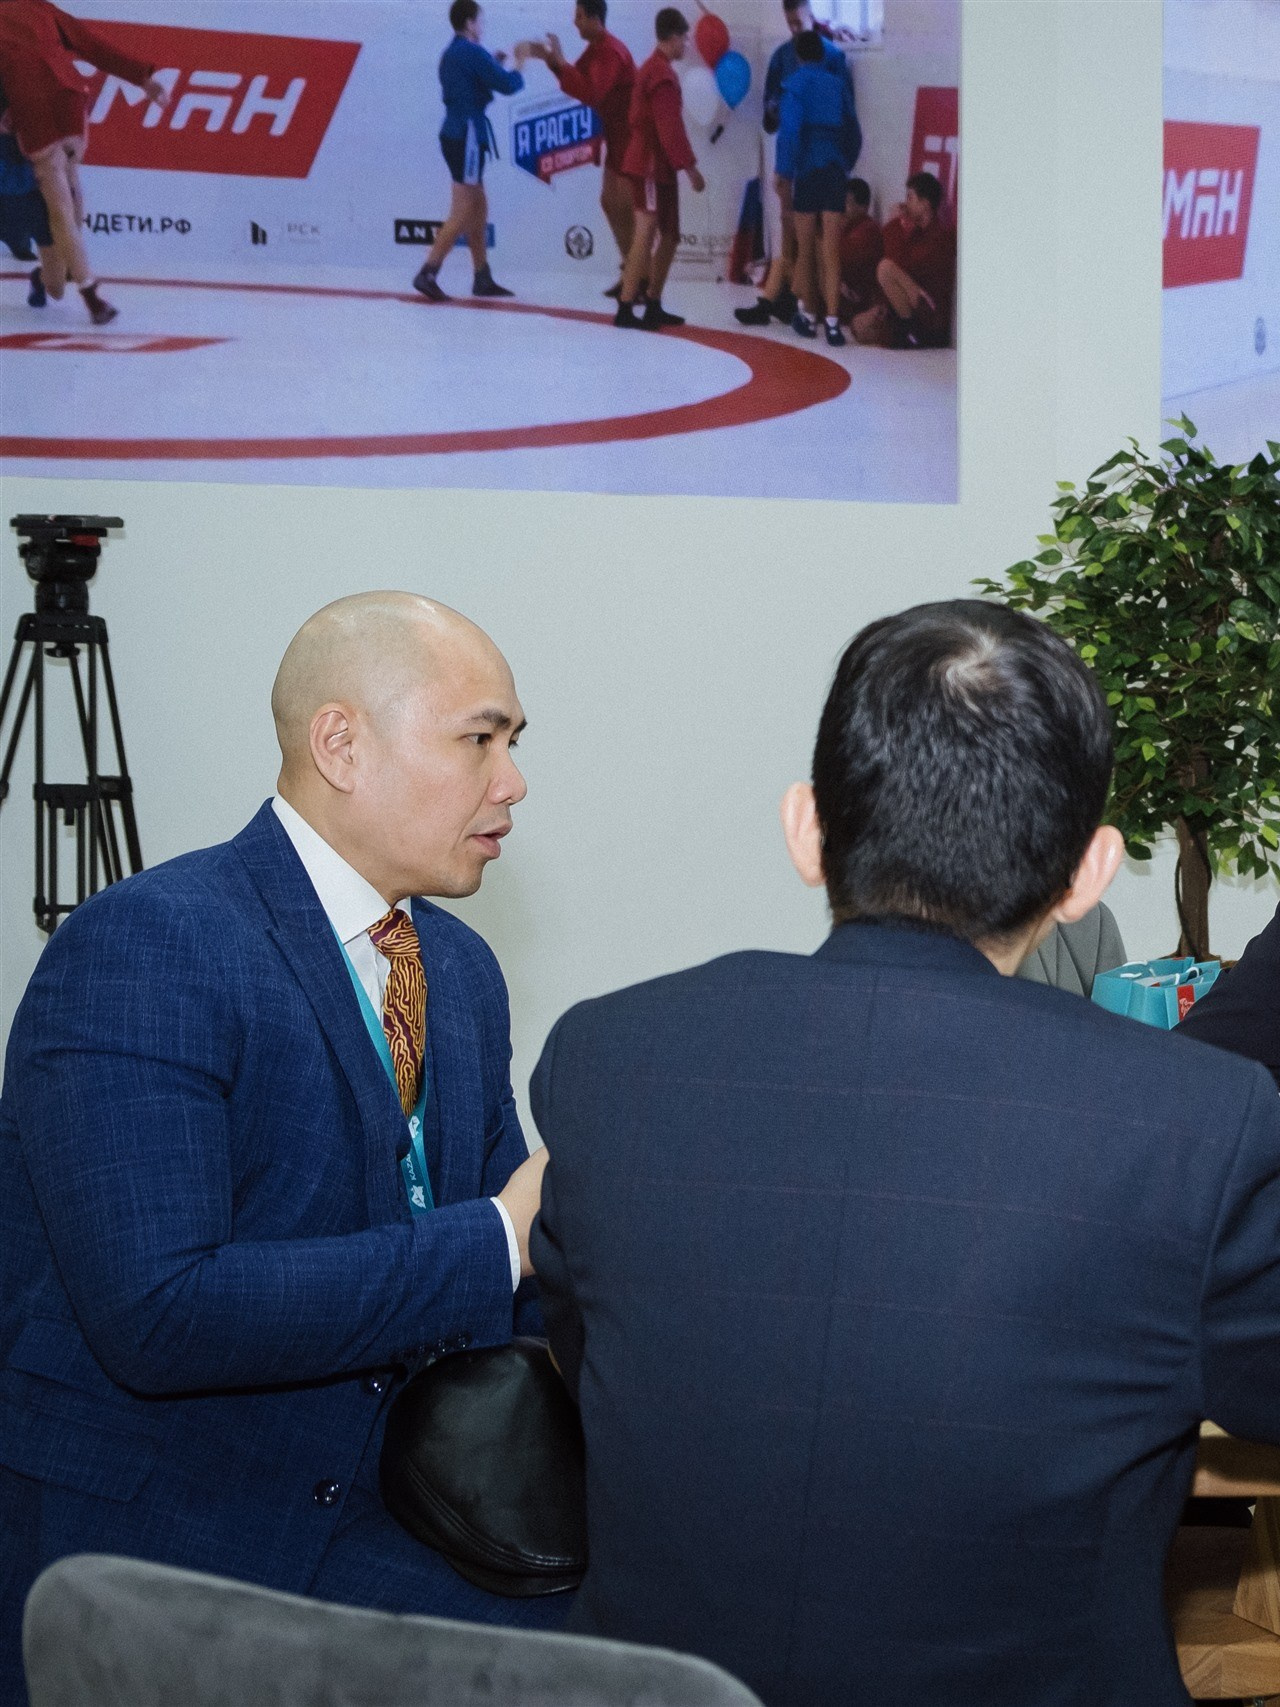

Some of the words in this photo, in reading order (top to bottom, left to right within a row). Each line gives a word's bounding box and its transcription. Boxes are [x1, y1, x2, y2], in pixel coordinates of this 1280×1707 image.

[72, 59, 306, 137] МАН
[535, 106, 592, 153] РАСТУ
[406, 1153, 416, 1180] KAZA
